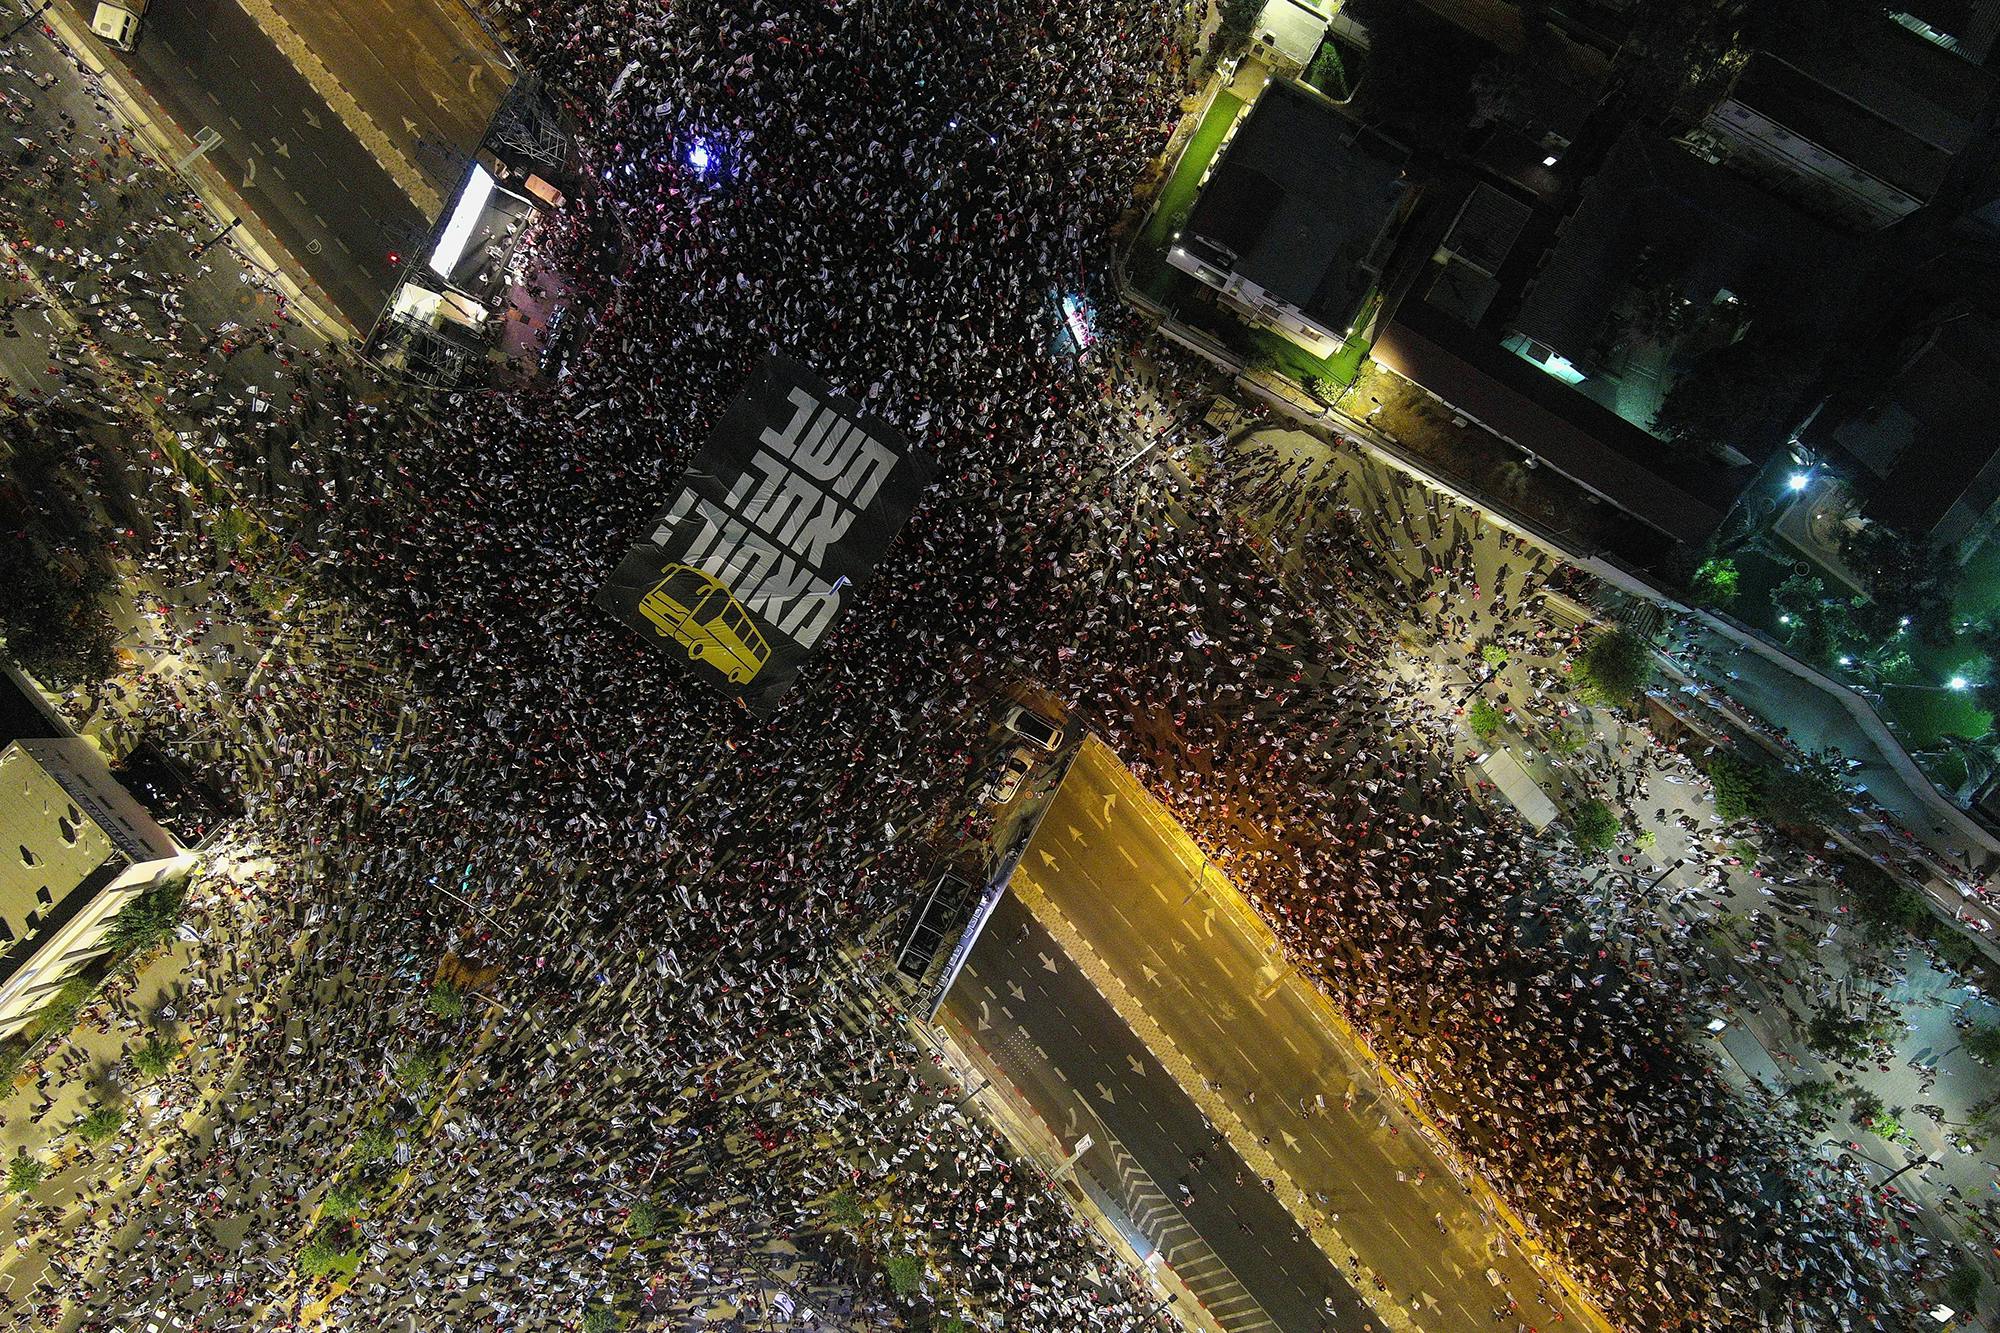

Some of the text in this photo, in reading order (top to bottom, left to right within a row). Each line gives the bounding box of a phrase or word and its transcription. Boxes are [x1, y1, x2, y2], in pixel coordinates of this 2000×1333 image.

[724, 449, 857, 569] אתה
[759, 385, 900, 511] תשב
[650, 487, 841, 649] מאחור!
